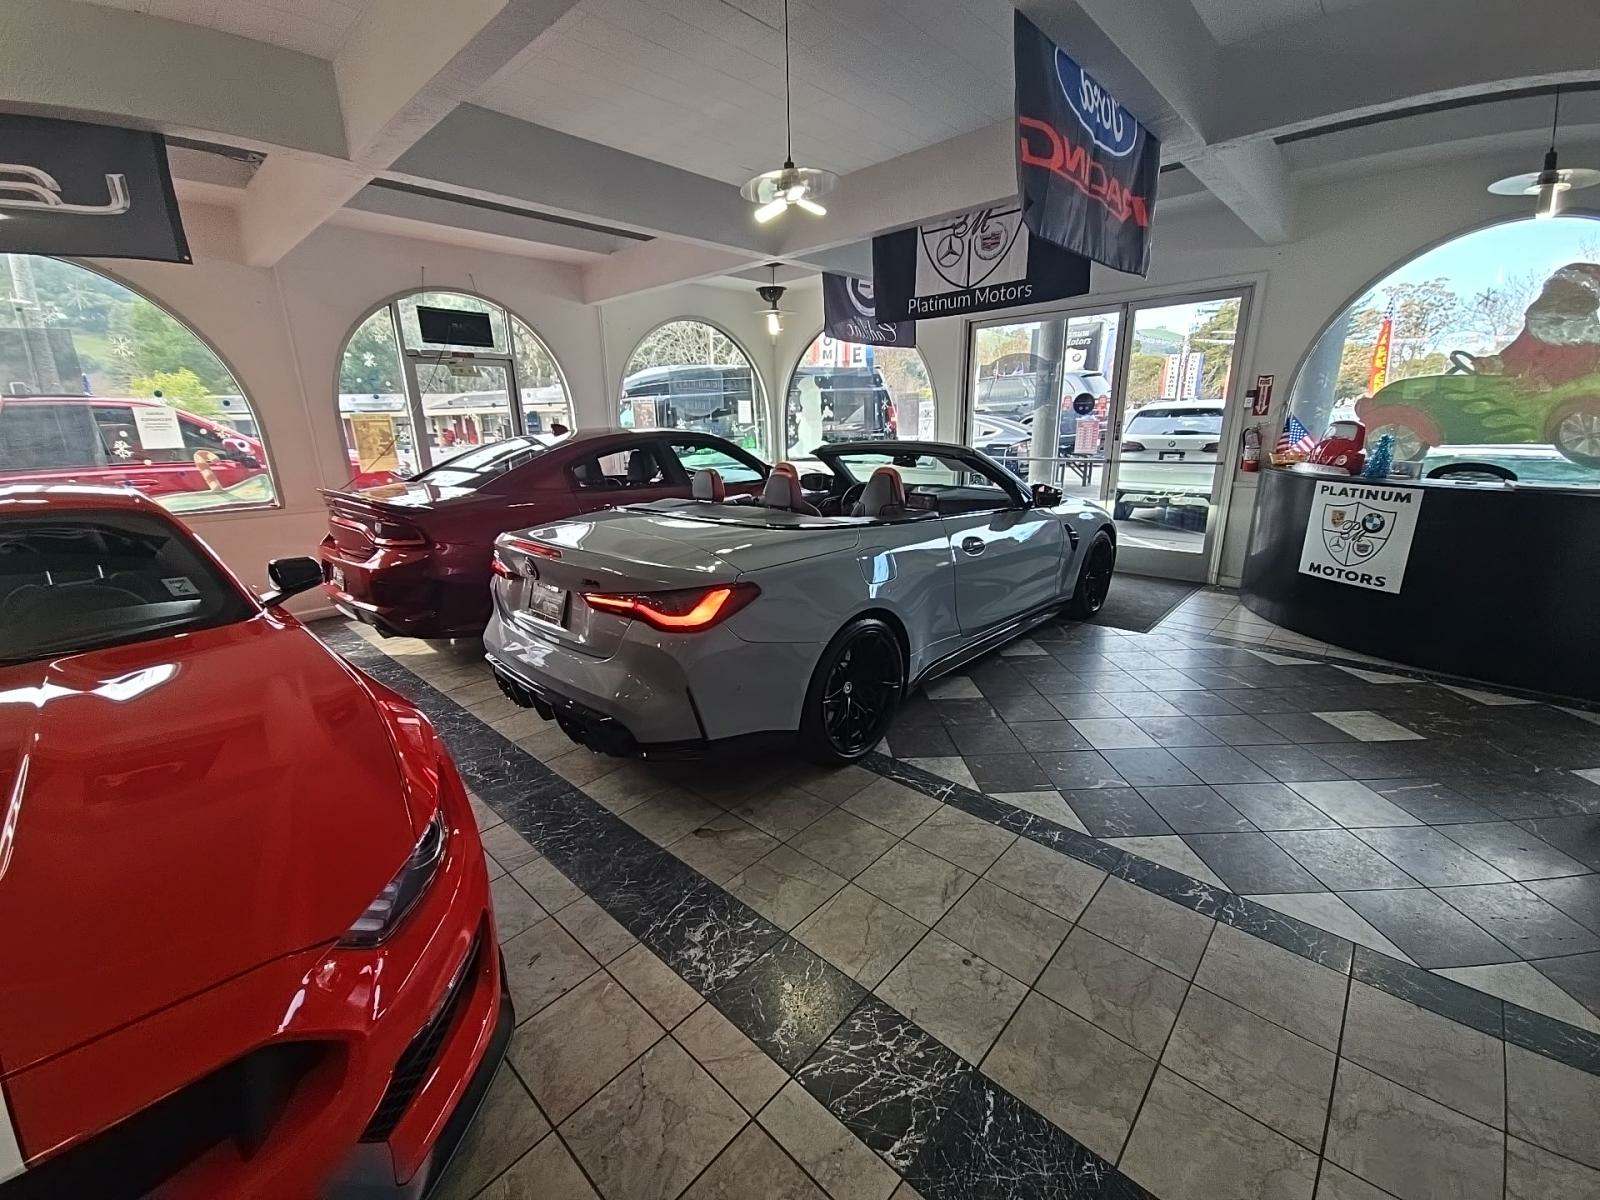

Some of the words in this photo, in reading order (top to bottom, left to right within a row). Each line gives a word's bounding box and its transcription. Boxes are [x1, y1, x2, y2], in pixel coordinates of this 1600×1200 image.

[907, 292, 972, 315] Platinum
[975, 283, 1033, 306] Motors
[1320, 484, 1413, 504] PLATINUM
[1308, 562, 1387, 588] MOTORS
